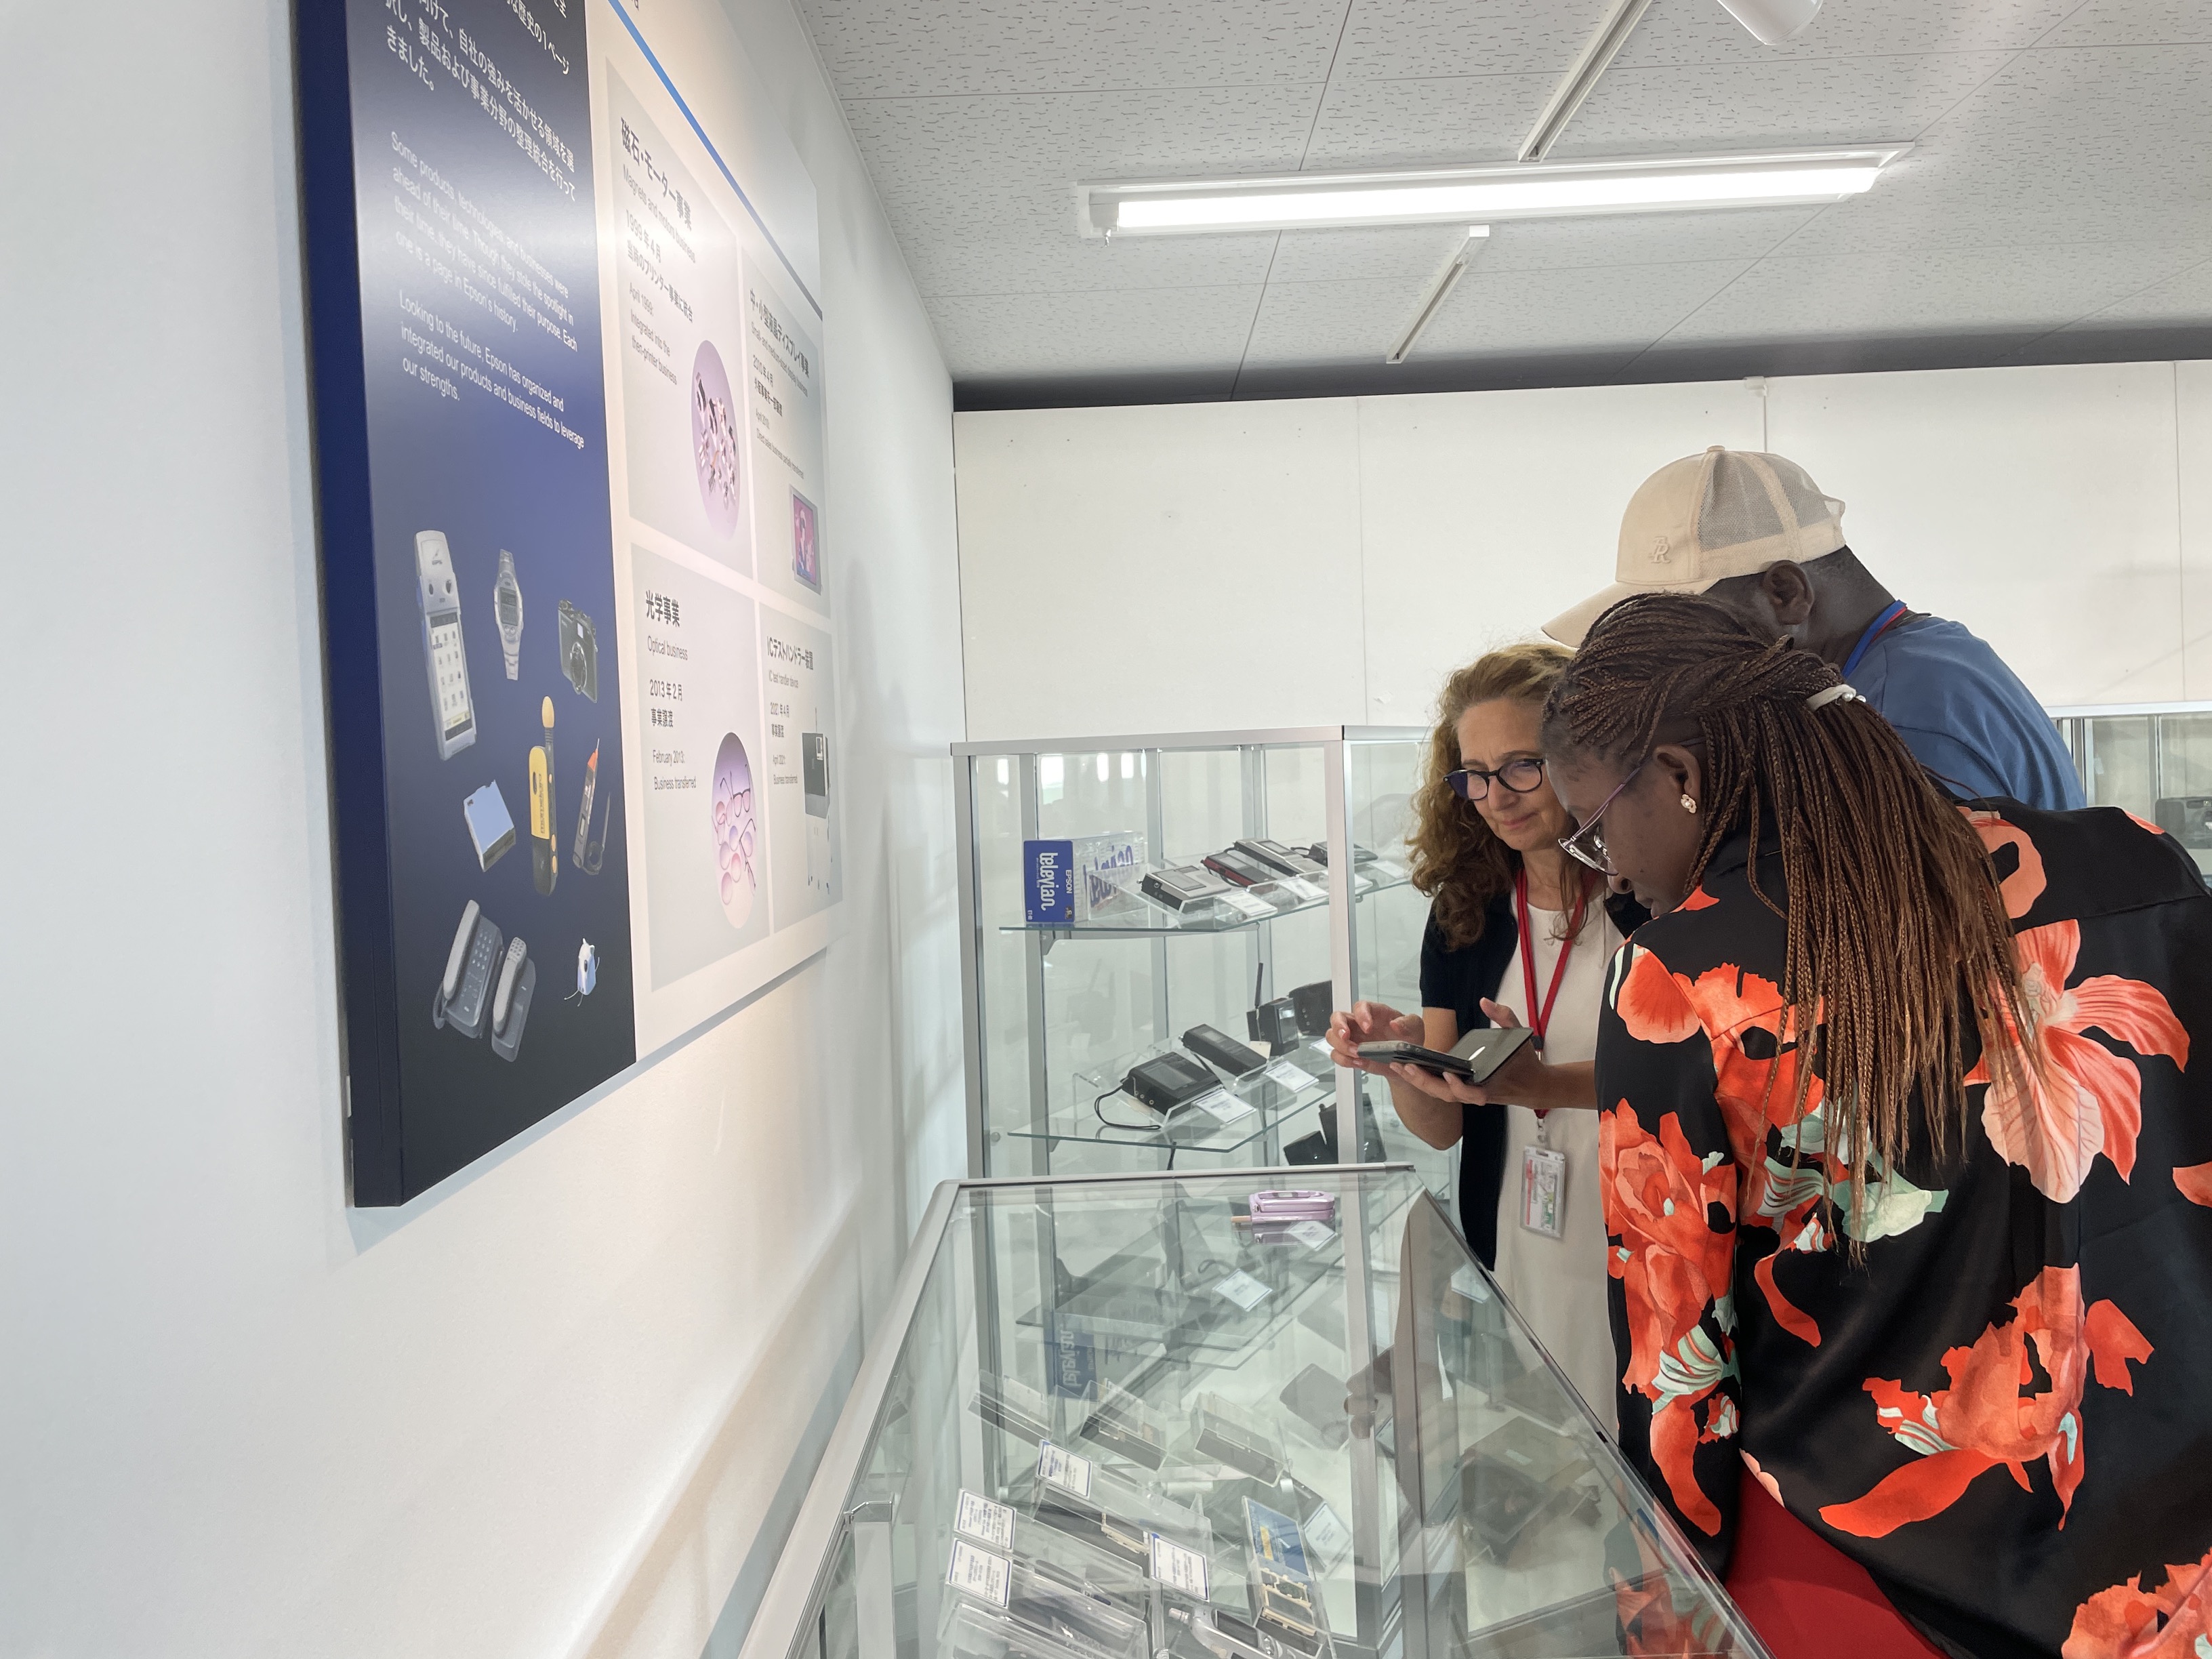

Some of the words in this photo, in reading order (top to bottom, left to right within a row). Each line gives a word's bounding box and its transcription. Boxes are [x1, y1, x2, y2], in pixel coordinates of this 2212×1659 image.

[386, 24, 434, 91] きました。
[620, 117, 692, 231] 磁石・モーター事業
[623, 163, 647, 205] Magnets
[647, 197, 658, 218] and
[391, 131, 417, 169] Some
[554, 278, 569, 298] were
[392, 167, 421, 200] ahead
[423, 191, 432, 209] of
[472, 229, 500, 267] Though
[501, 255, 516, 281] they
[533, 282, 542, 301] the
[425, 252, 431, 267] a
[433, 259, 453, 285] page
[455, 270, 462, 288] in
[464, 277, 493, 312] Epson's
[493, 302, 518, 333] history.
[457, 245, 476, 274] have
[478, 265, 497, 289] since
[522, 297, 535, 320] their
[537, 312, 562, 341] purpose.
[563, 329, 578, 352] Each
[398, 289, 434, 331] Looking
[435, 314, 444, 334] to
[445, 321, 459, 344] the
[459, 330, 485, 363] future,
[485, 346, 508, 375] Epson
[508, 362, 521, 385] has
[522, 374, 552, 405] organized
[552, 397, 564, 413] and
[403, 357, 418, 377] our
[419, 365, 461, 402] strengths.
[401, 321, 444, 364] integrated
[445, 352, 459, 373] our
[461, 362, 493, 393] products
[493, 382, 507, 402] and
[508, 388, 536, 420] business
[537, 407, 553, 430] fields
[554, 420, 560, 434] to
[560, 420, 585, 450] leverage
[645, 590, 680, 628] 光学事業
[647, 635, 666, 657] Optical
[666, 641, 688, 661] business
[653, 750, 672, 766] February
[654, 776, 674, 791] Business
[674, 775, 697, 790] transferred
[1038, 852, 1060, 912] televian
